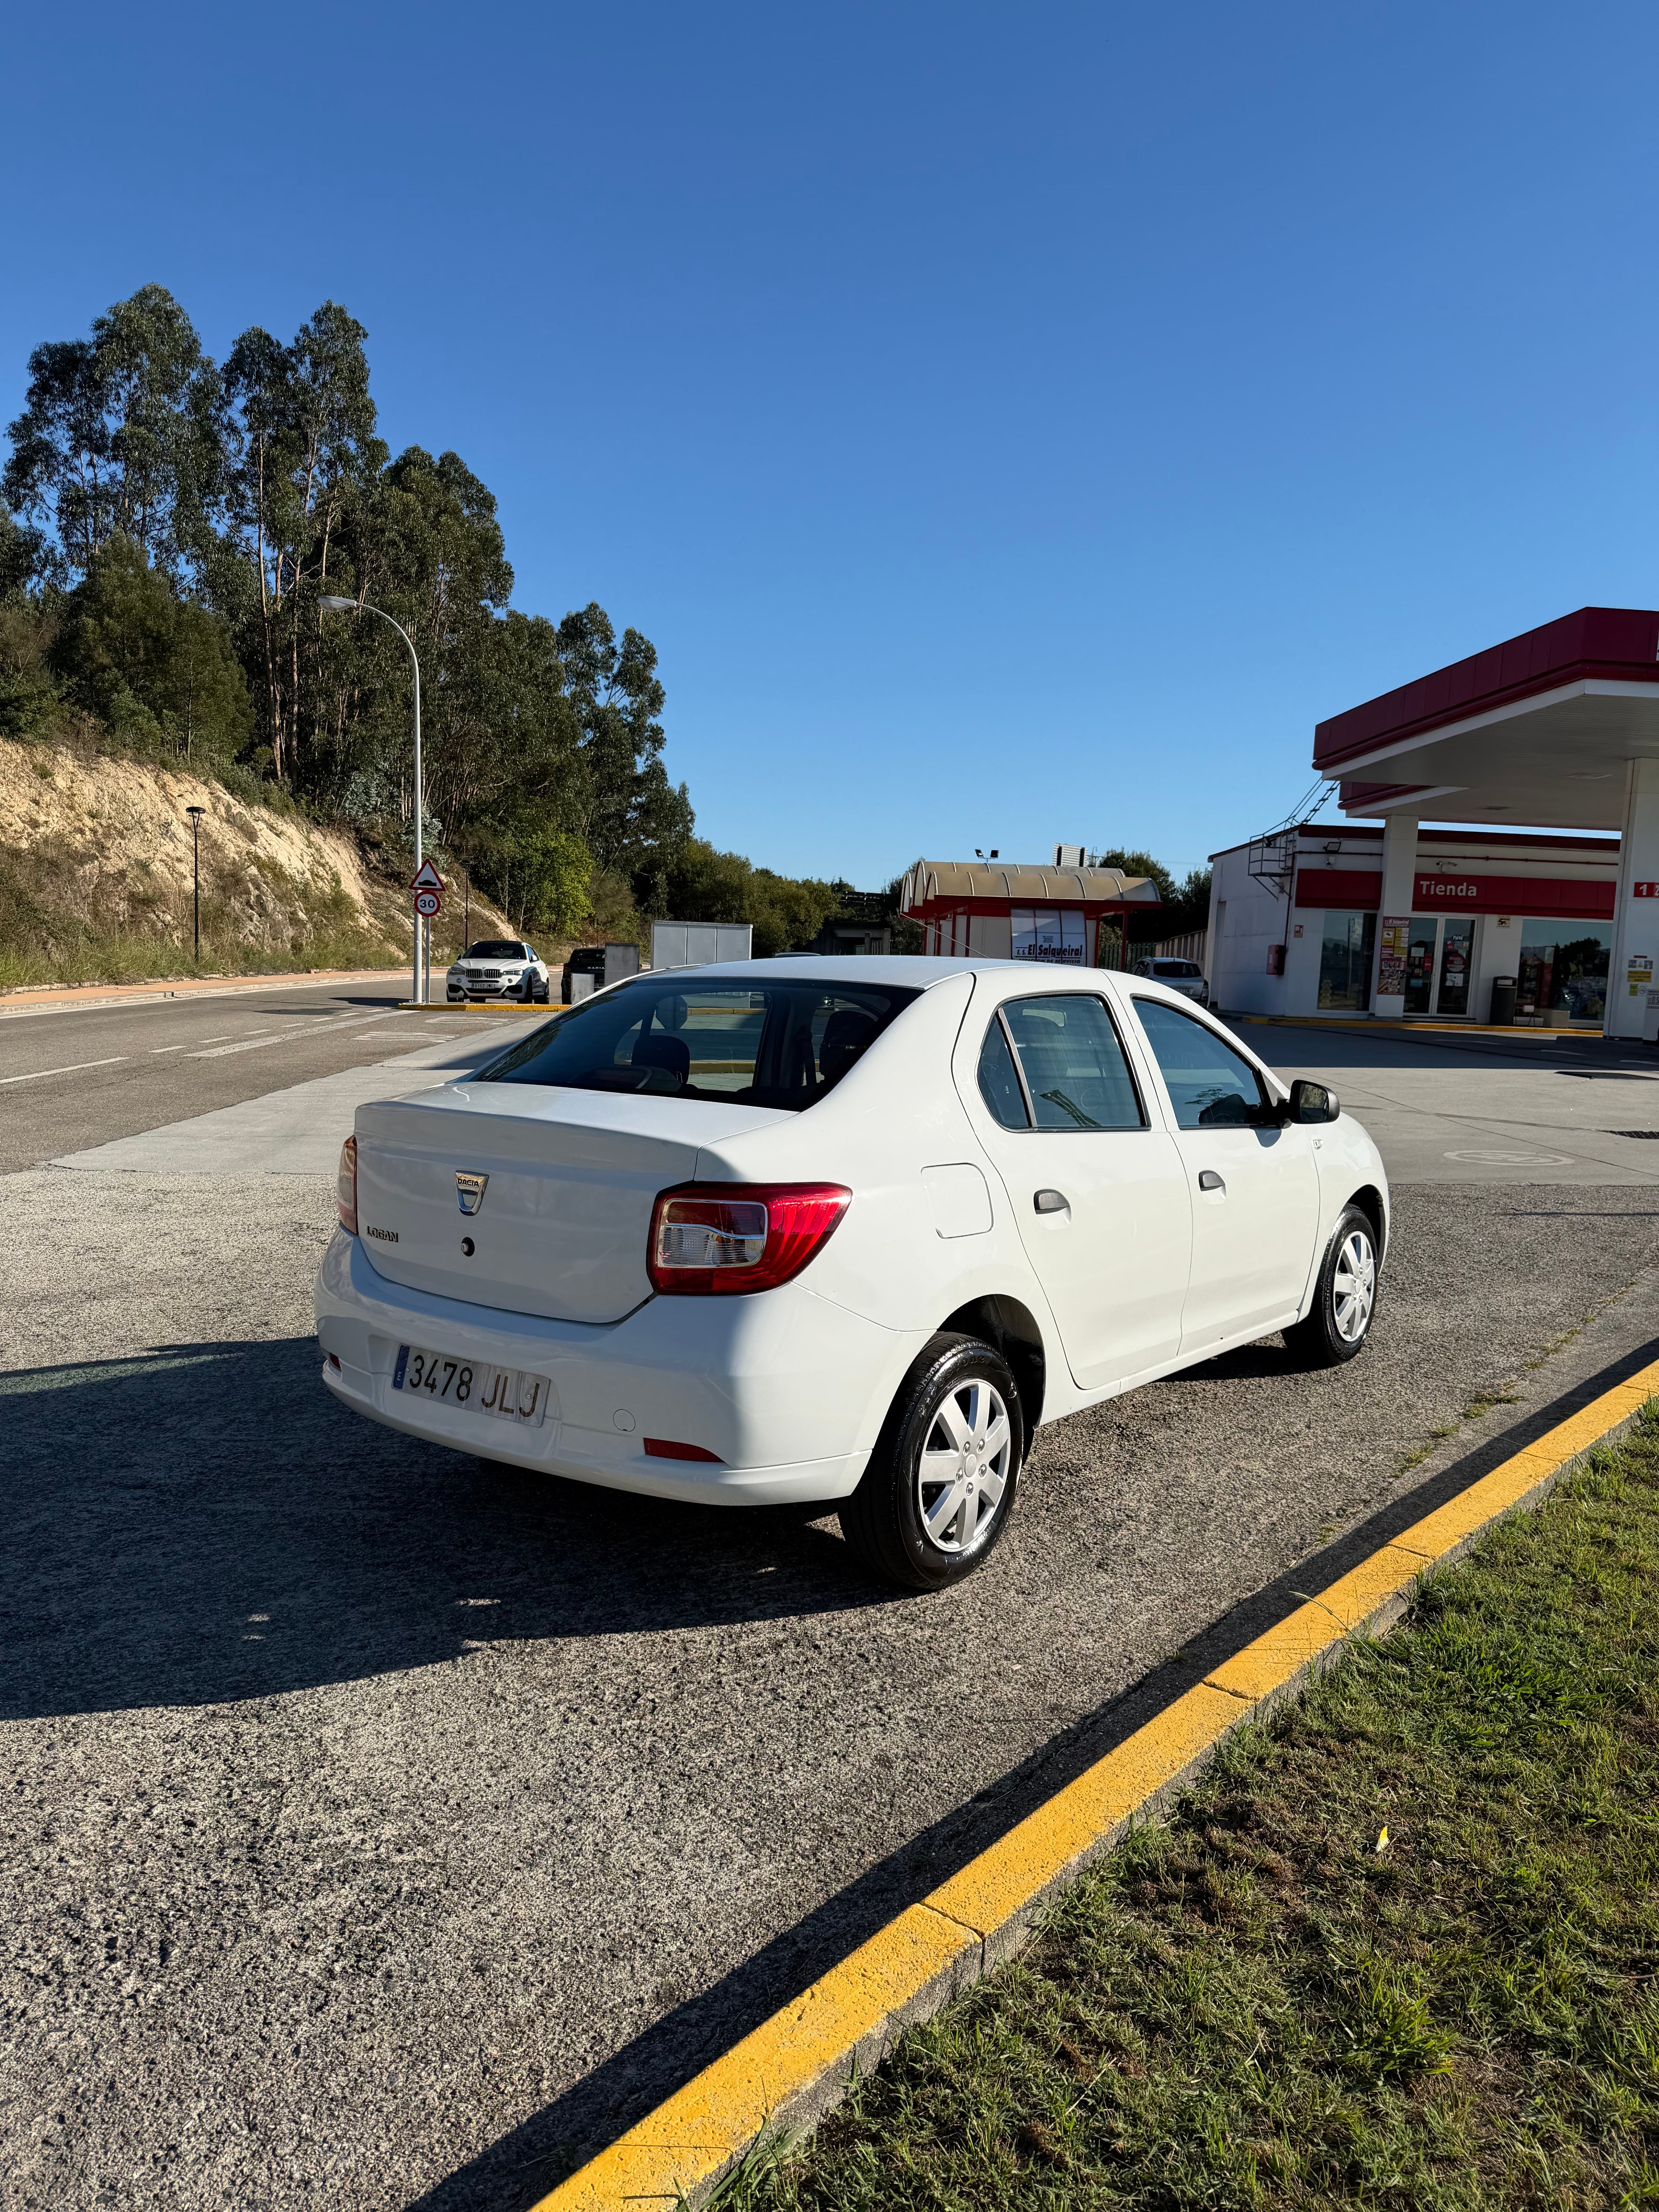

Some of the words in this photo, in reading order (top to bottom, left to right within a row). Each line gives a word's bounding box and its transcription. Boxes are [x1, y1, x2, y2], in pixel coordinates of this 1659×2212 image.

[1420, 881, 1477, 896] Tienda
[1639, 884, 1647, 896] 1
[420, 900, 435, 908] 30
[1028, 944, 1036, 955] El
[1038, 944, 1083, 957] Salgueiral
[457, 1178, 479, 1187] DACIA
[366, 1226, 398, 1243] LOGAN
[397, 1371, 402, 1381] E
[409, 1355, 473, 1401] 3478
[481, 1374, 540, 1417] JLJ
